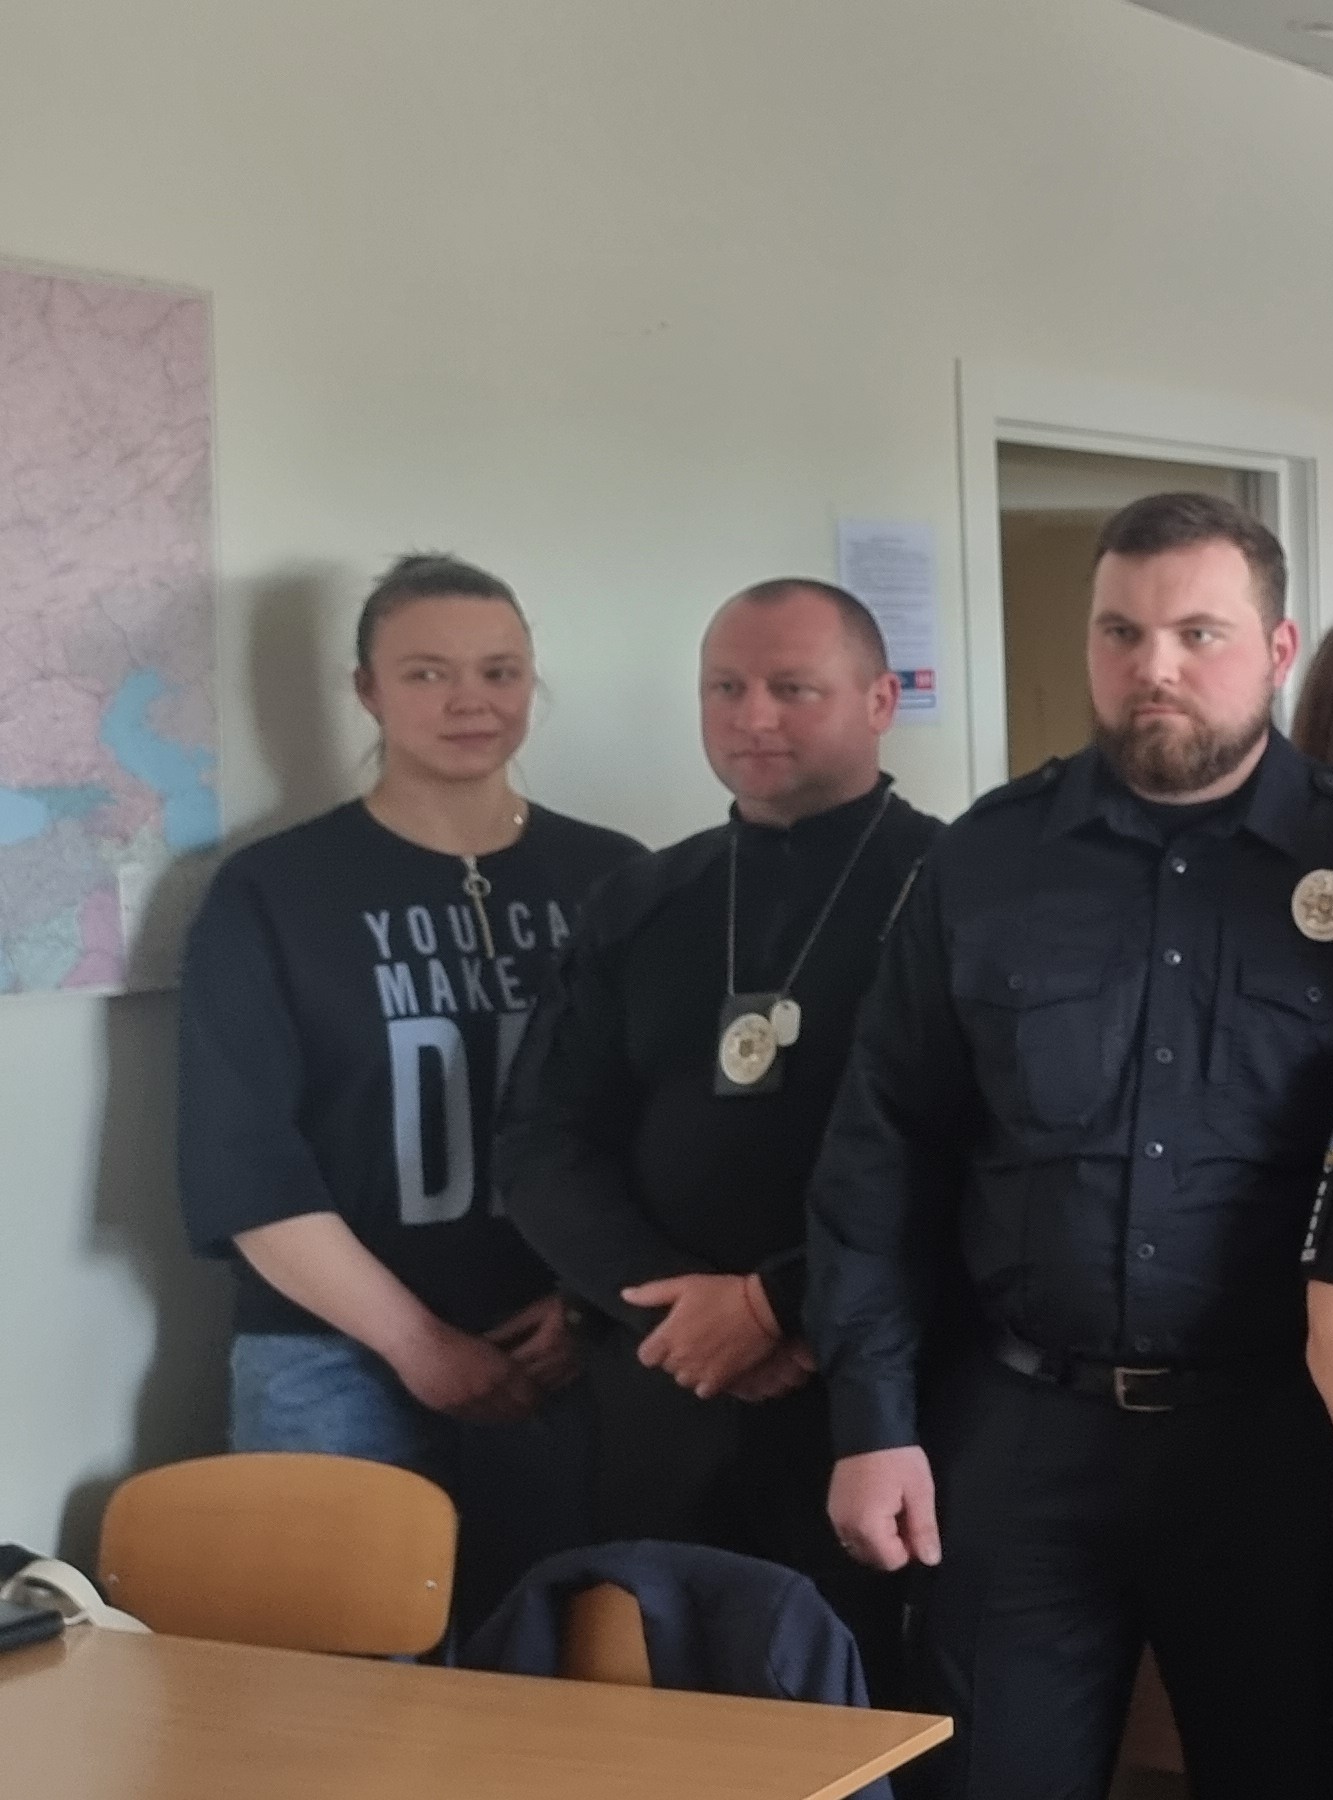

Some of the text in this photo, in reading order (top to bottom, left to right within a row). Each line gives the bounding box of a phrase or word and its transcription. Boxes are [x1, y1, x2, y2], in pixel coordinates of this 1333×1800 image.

[363, 900, 576, 959] YOU CA
[374, 954, 528, 1018] MAKE
